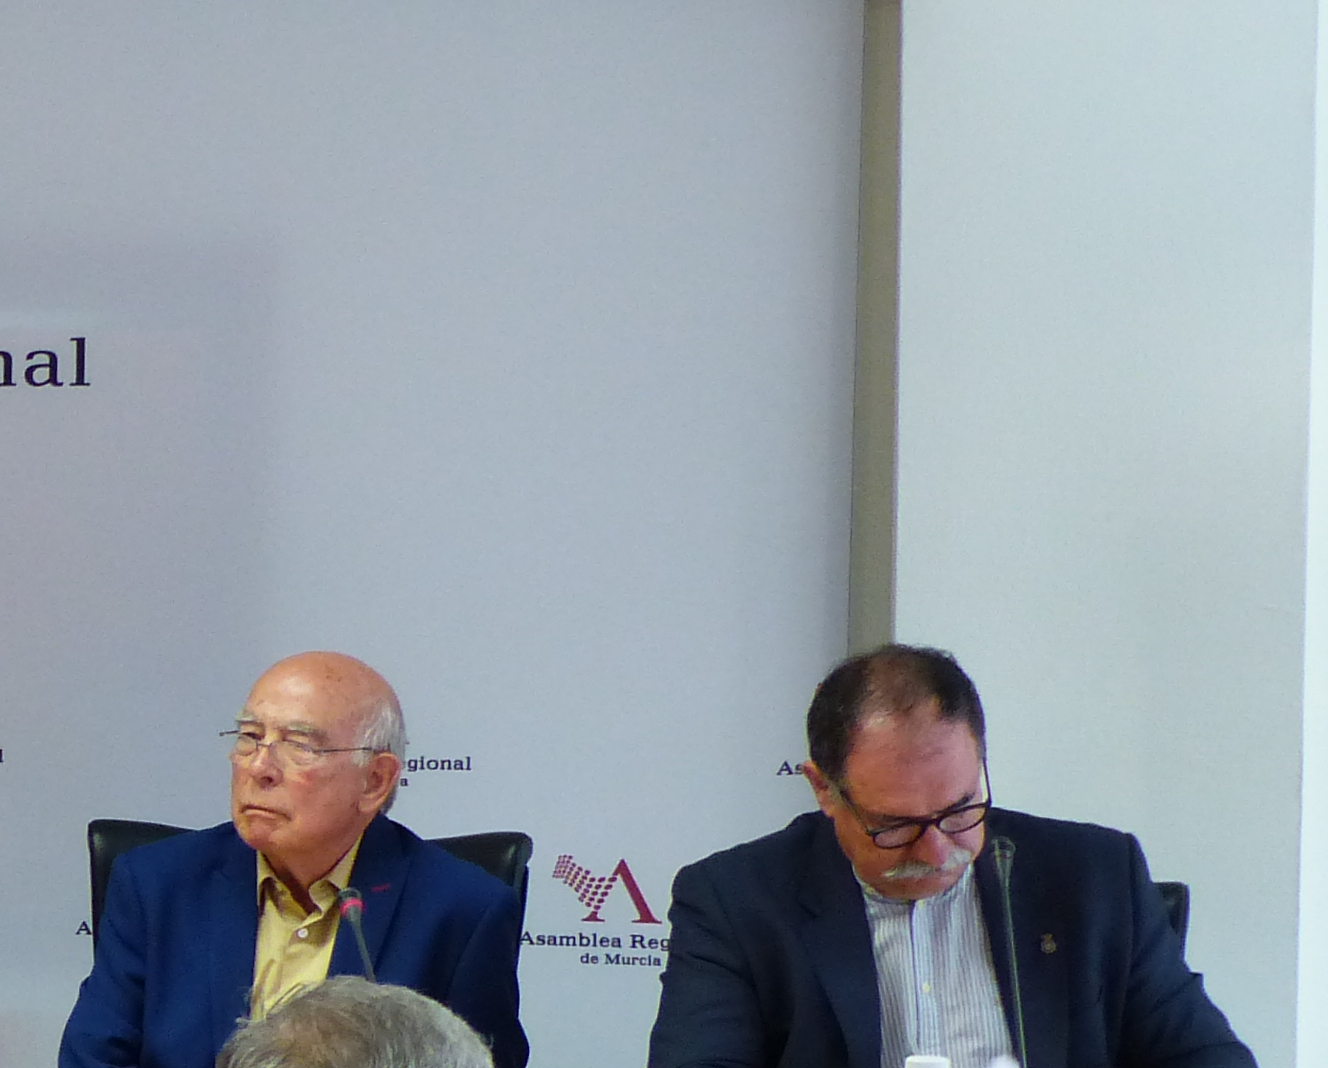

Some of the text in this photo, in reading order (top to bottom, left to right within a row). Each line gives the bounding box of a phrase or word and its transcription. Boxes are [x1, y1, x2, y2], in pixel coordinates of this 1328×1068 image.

[407, 756, 473, 772] gional
[520, 931, 622, 948] Asamblea
[579, 953, 662, 967] de Murcia
